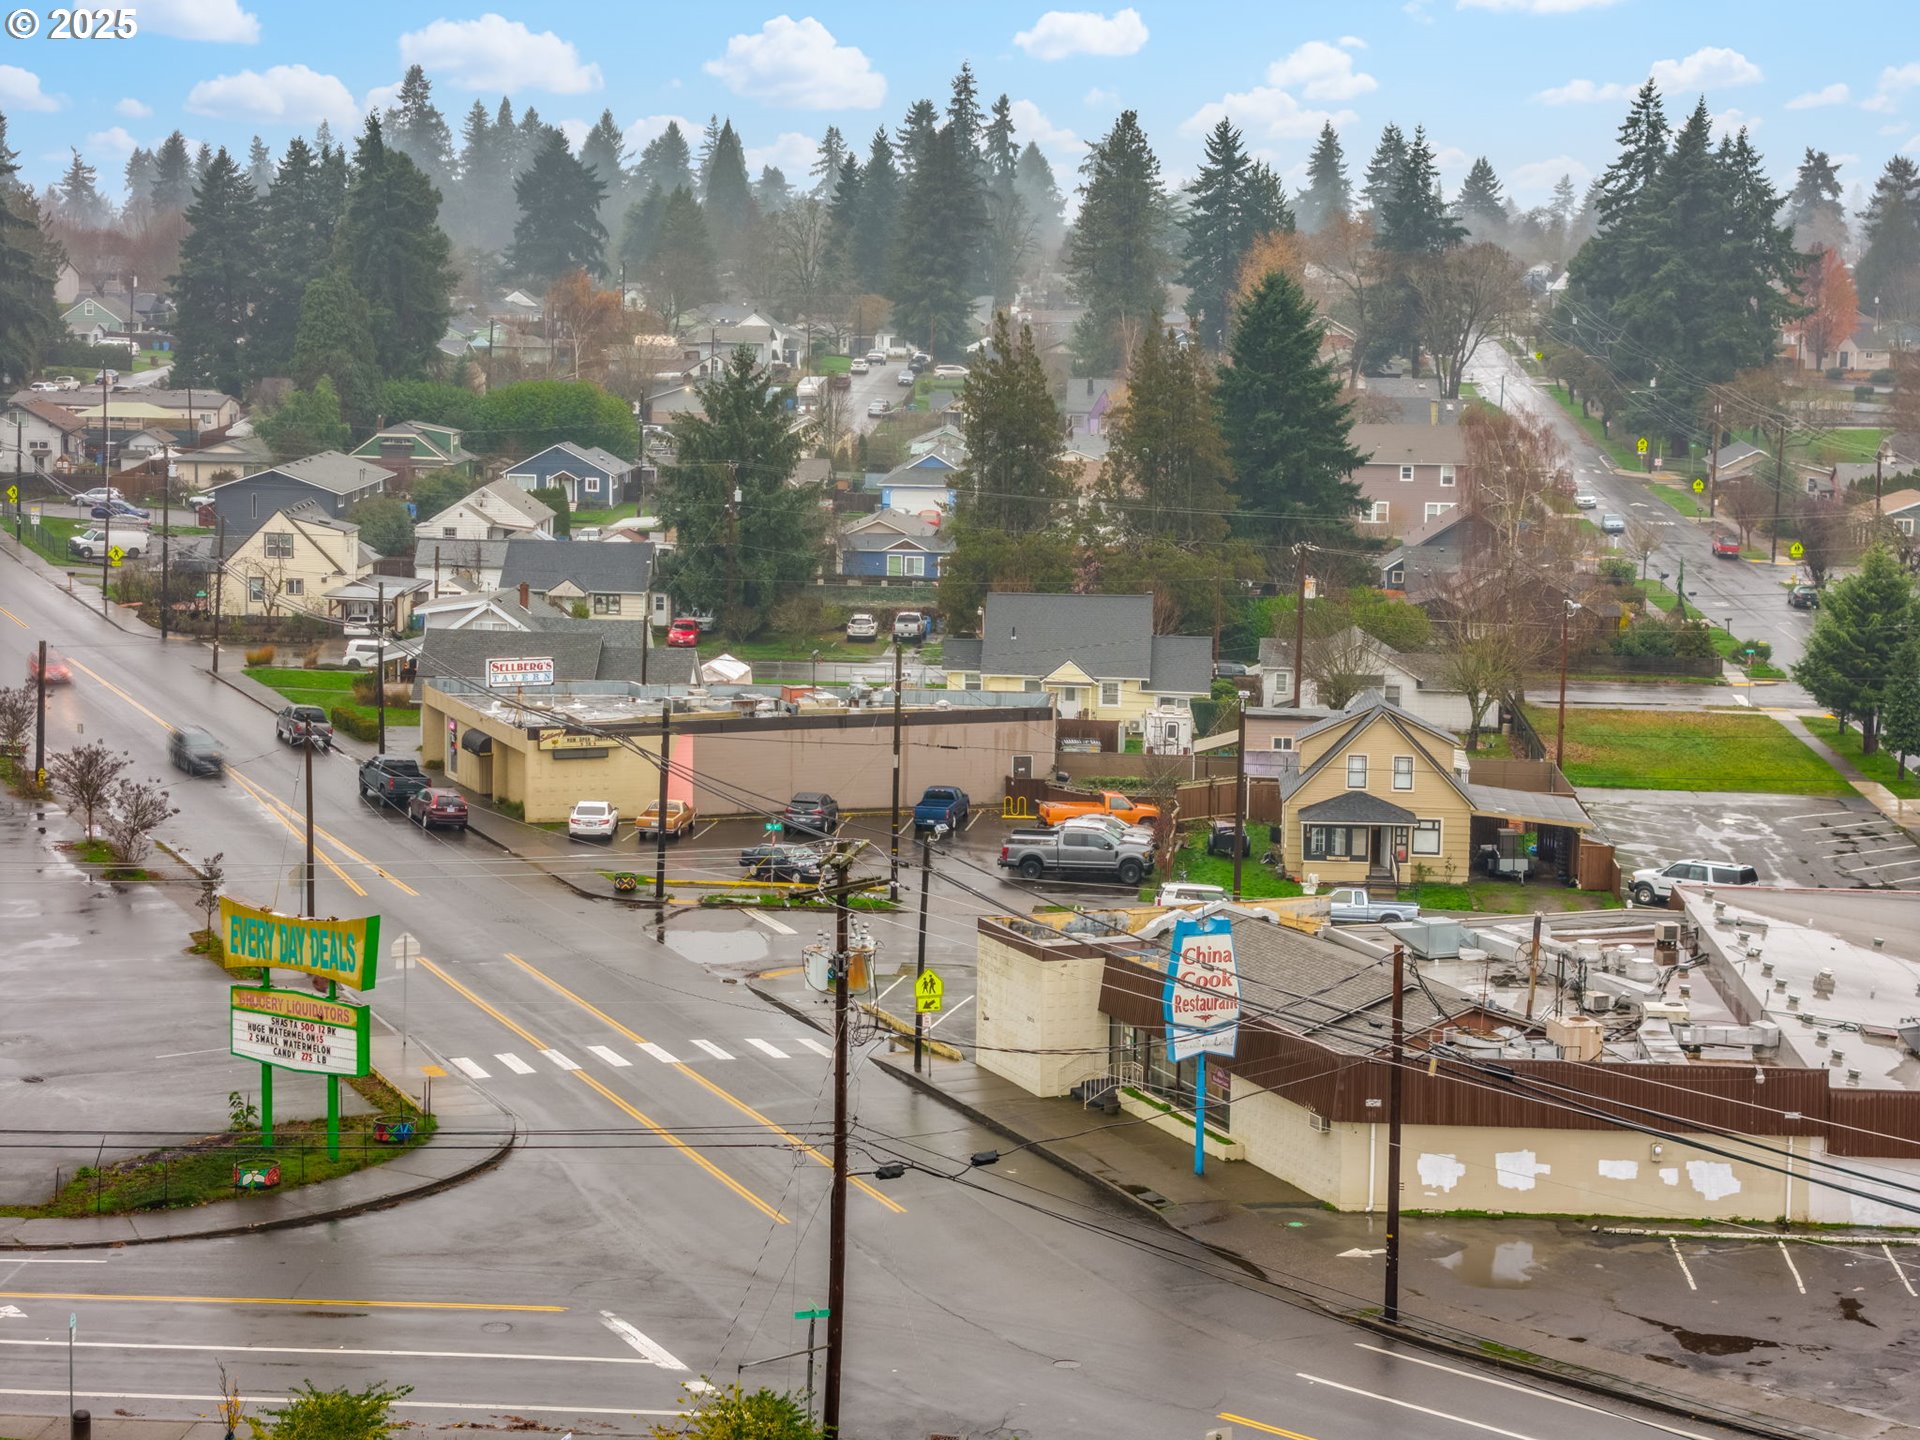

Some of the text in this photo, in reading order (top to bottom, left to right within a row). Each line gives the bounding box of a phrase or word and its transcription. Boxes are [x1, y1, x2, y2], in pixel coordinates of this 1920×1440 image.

[492, 672, 551, 682] TAVERN
[230, 915, 356, 973] EVERY DAY DEALS
[1181, 945, 1233, 965] China
[1179, 968, 1233, 989] Cook
[240, 991, 350, 1023] GROCERY LIQUIDATORS
[1174, 992, 1238, 1014] Restaurant
[247, 1023, 265, 1033] HUGE
[271, 1017, 297, 1029] SHASTA
[249, 1032, 331, 1055] 2 SMALL WATERMELON
[273, 1047, 296, 1059] CANDY
[317, 1056, 327, 1064] LB
